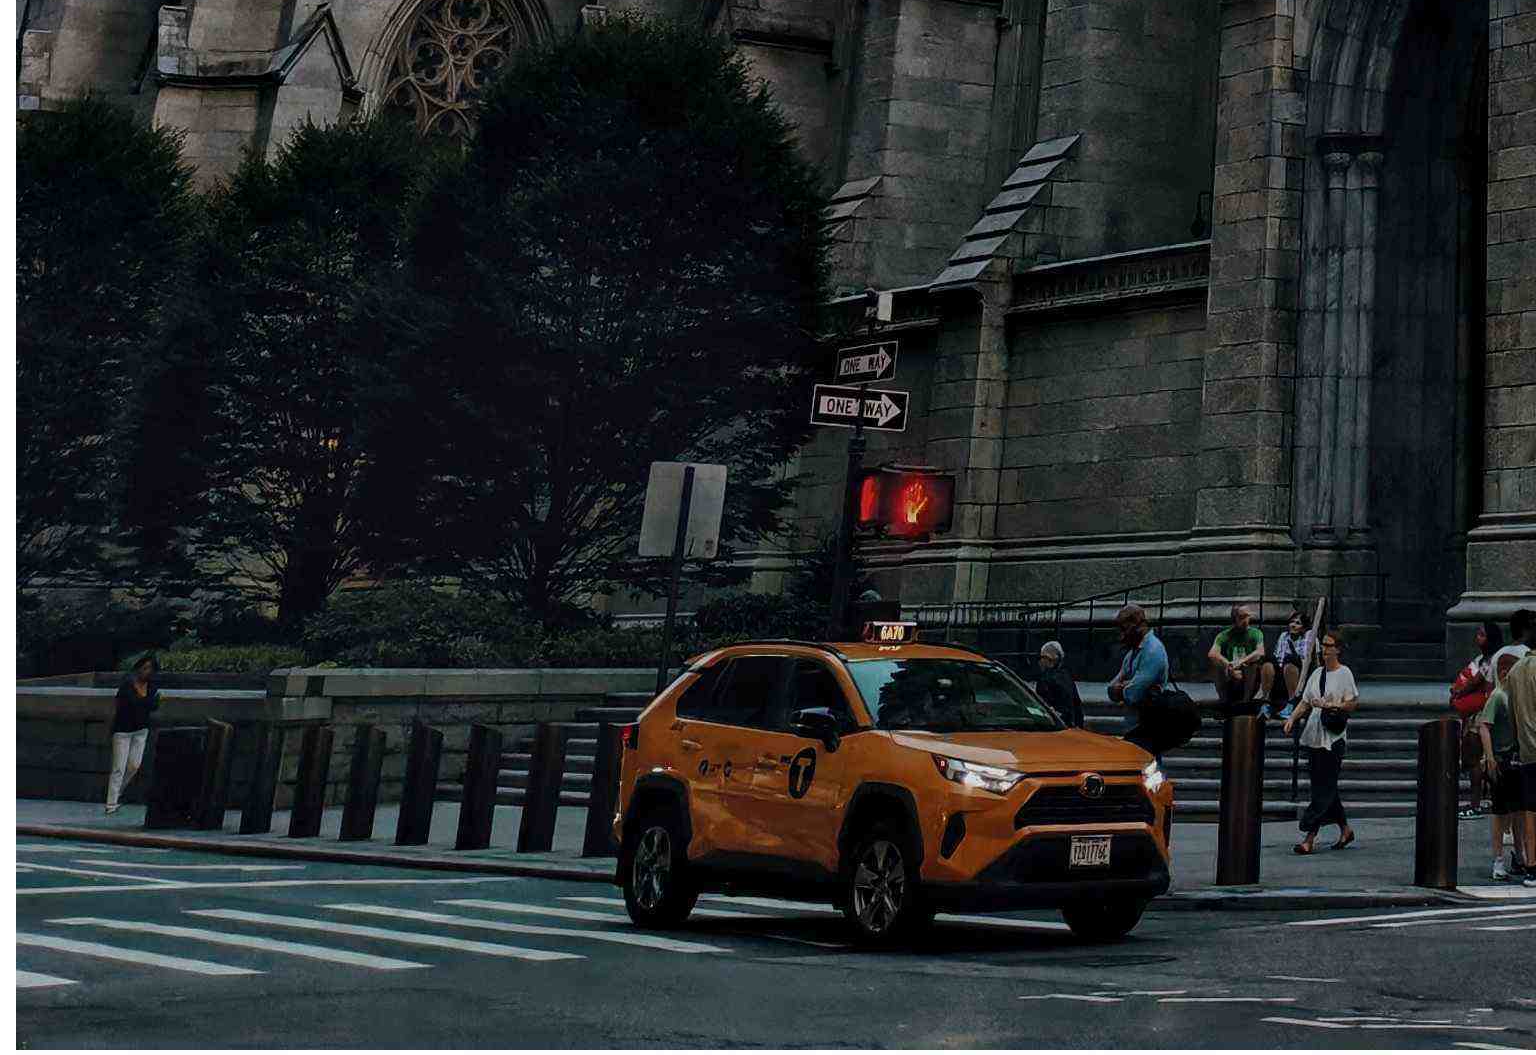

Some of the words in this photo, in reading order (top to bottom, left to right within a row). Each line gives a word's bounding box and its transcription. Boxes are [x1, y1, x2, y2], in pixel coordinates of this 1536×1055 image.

[843, 357, 861, 374] ONE
[867, 353, 887, 371] WAY
[827, 397, 853, 414] ONE
[864, 401, 892, 418] WAY
